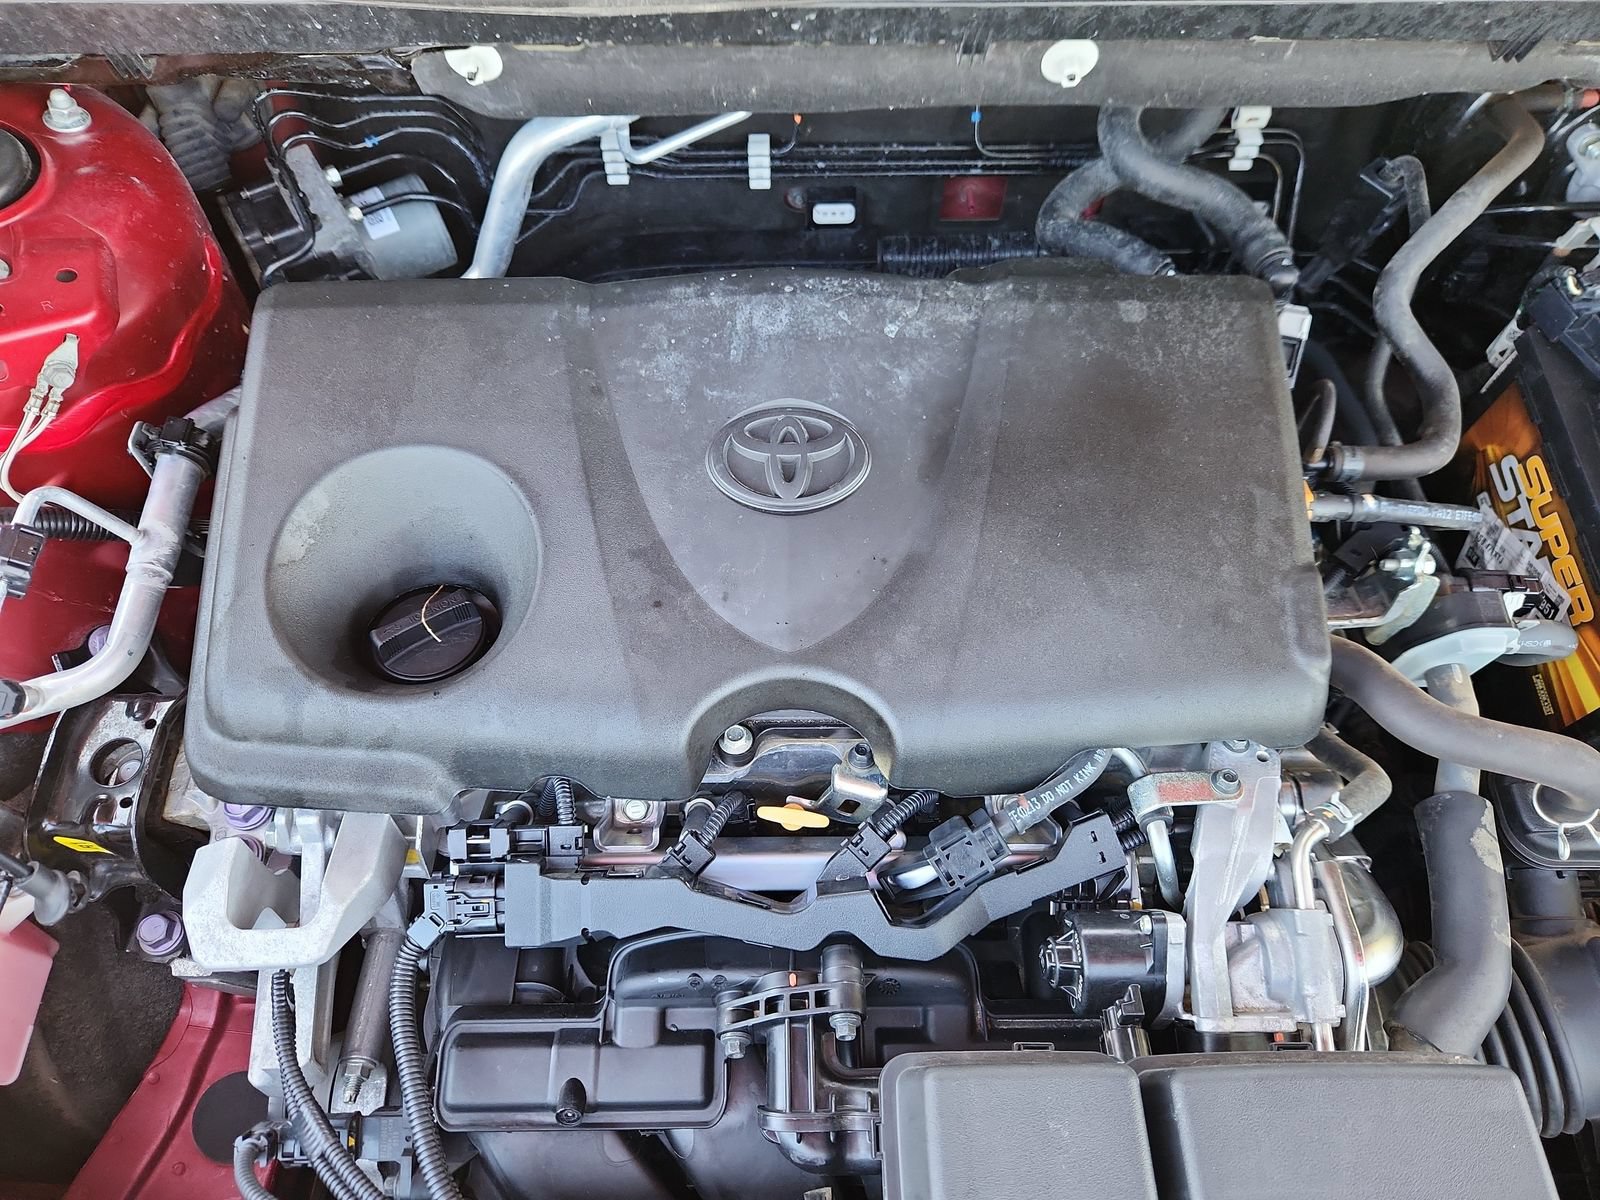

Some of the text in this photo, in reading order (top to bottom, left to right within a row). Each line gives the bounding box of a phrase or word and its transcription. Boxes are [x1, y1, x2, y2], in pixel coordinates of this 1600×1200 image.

[1517, 454, 1595, 627] SUPER
[1040, 790, 1055, 804] DO
[1054, 779, 1074, 797] NOT
[1073, 761, 1097, 784] KINK
